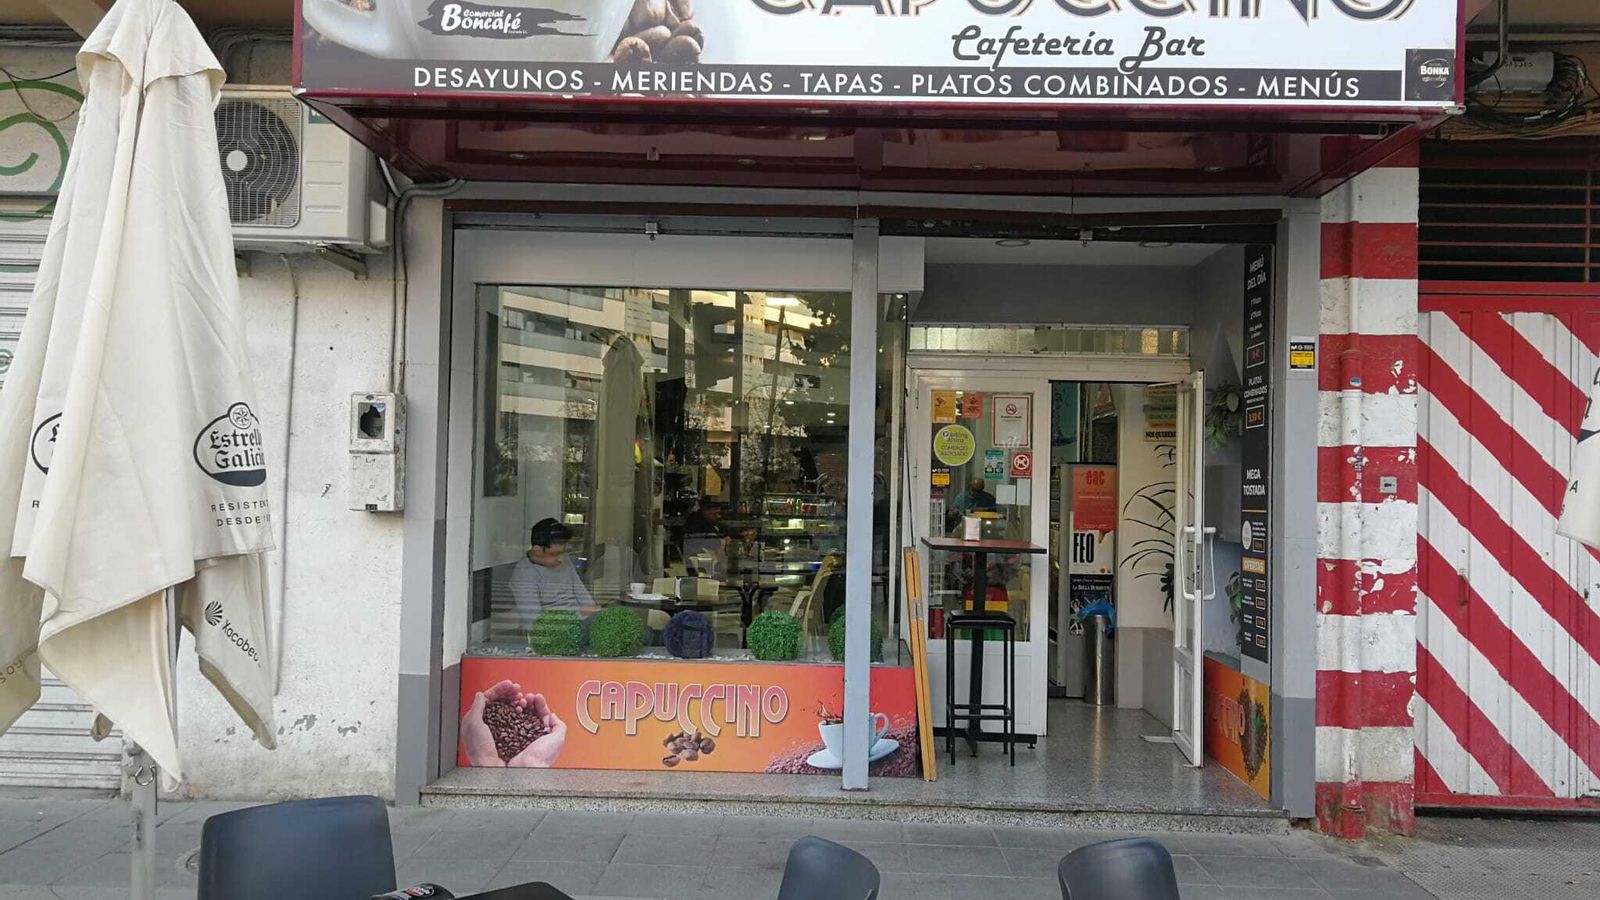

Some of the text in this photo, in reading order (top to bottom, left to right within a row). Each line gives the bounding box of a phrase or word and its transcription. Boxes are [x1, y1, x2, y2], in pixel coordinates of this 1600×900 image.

[441, 3, 523, 34] Boncafé
[463, 9, 505, 18] Comercial
[951, 24, 1206, 74] Cafetería Bar
[1420, 65, 1450, 76] BONKA
[413, 66, 584, 91] DESAYUNOS
[611, 68, 774, 93] MERIENDAS
[800, 72, 884, 94] TAPAS
[911, 73, 1013, 96] PLATOS
[1023, 74, 1229, 98] COMBINADOS
[1256, 70, 1361, 98] MENÚS
[1246, 468, 1262, 480] MEGA
[1243, 484, 1266, 497] TOSTADA
[216, 516, 262, 527] DESDE
[1073, 533, 1095, 564] FEO
[576, 679, 790, 738] CAPUCCINO
